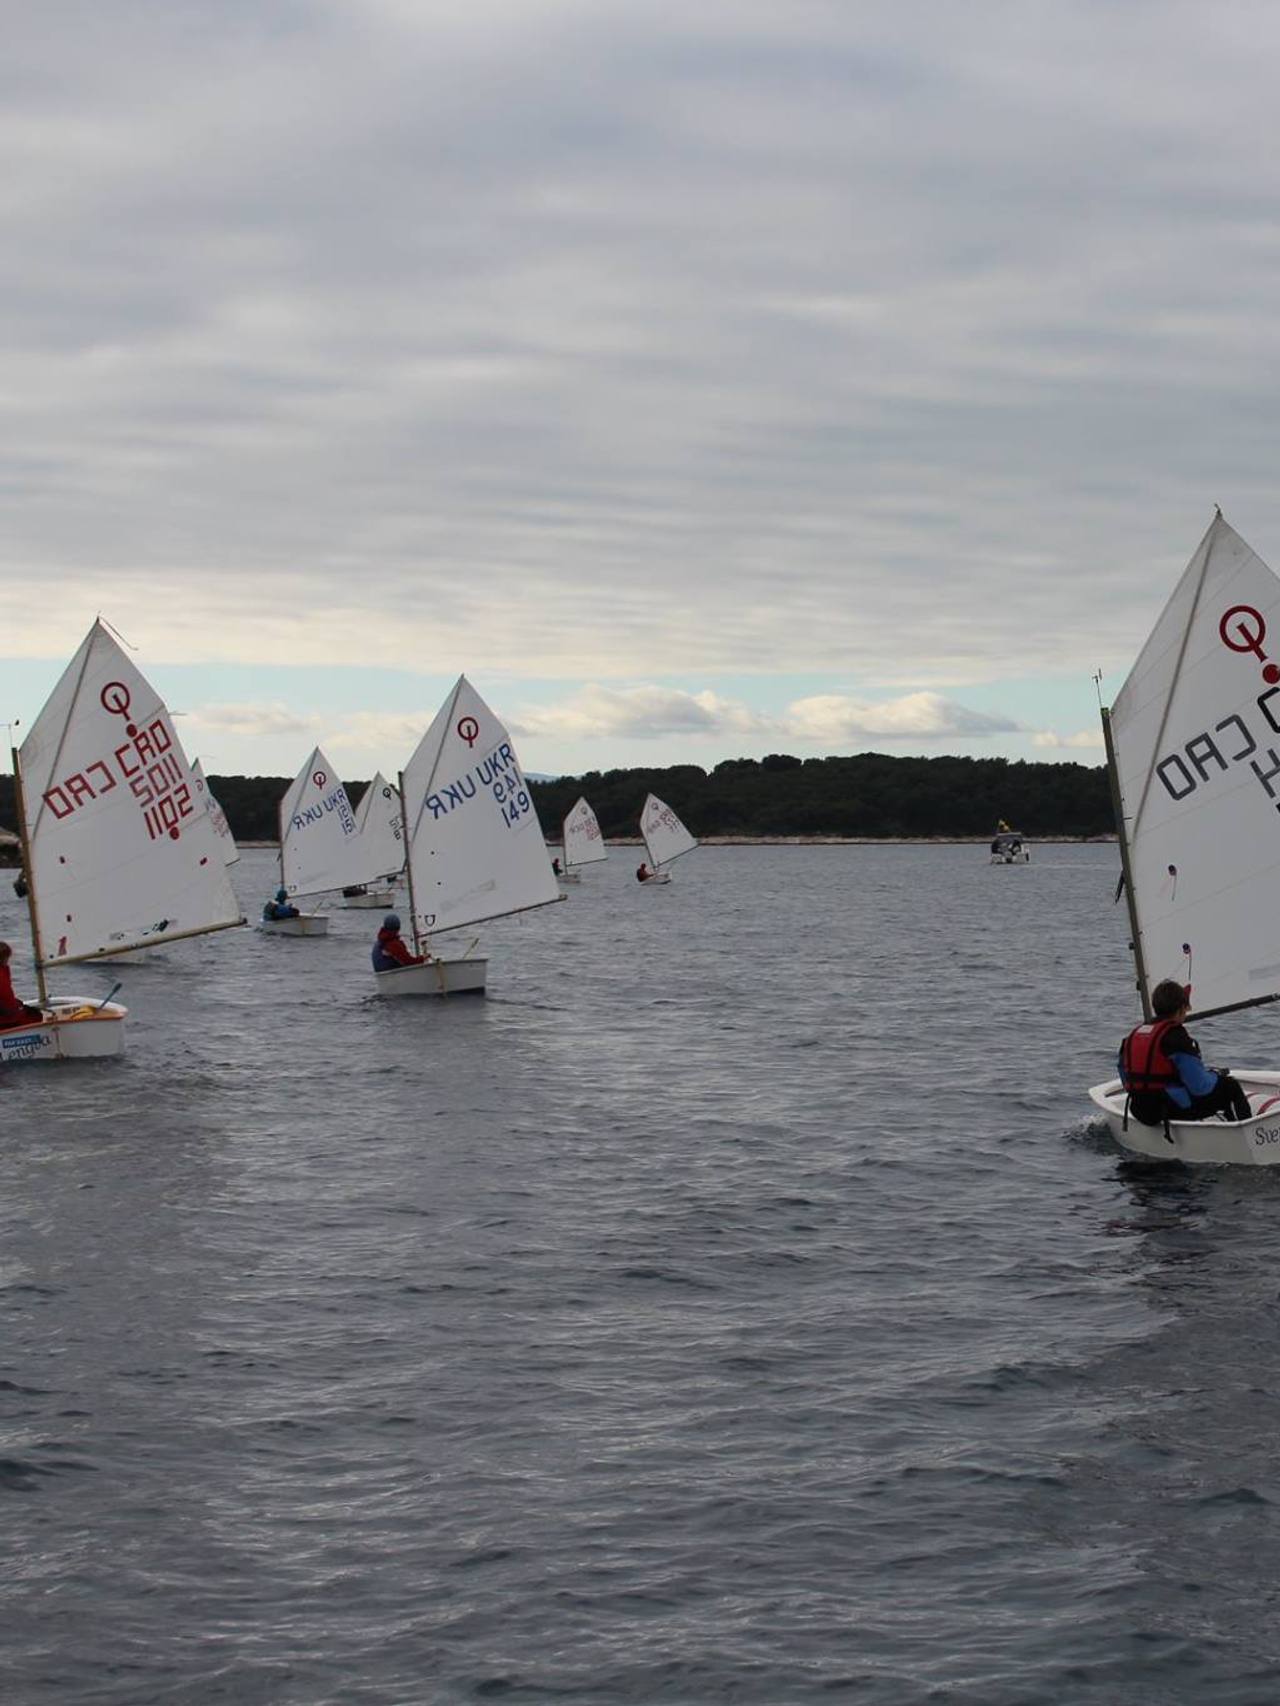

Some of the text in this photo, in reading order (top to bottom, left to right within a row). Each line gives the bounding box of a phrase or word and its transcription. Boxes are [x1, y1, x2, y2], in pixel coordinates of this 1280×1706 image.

[476, 743, 515, 786] UKR
[143, 783, 194, 841] 1102
[501, 790, 530, 829] 149
